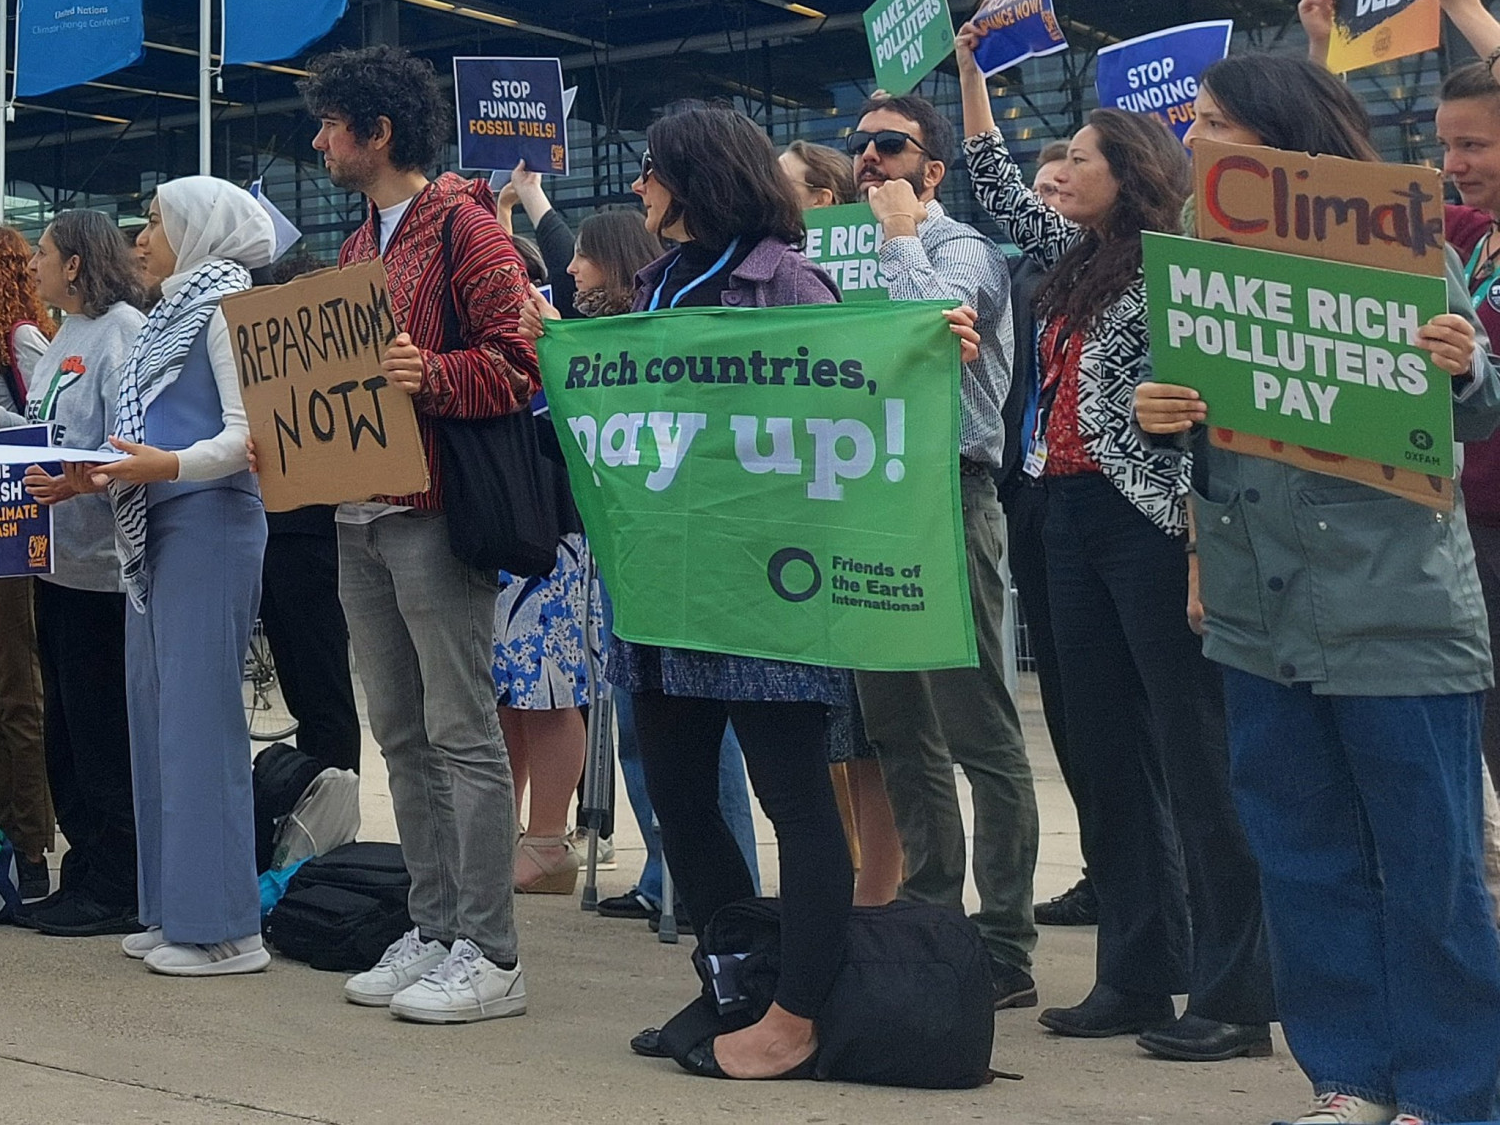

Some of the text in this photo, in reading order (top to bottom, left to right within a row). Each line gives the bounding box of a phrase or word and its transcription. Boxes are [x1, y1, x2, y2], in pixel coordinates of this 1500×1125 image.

[901, 35, 924, 75] PAY
[492, 80, 530, 98] STOP
[1128, 57, 1174, 89] STOP
[479, 100, 546, 120] FUNDING
[1116, 76, 1198, 113] FUNDING
[470, 119, 556, 139] FOSSIL FUELS!
[1169, 264, 1419, 347] MAKE RICH
[1167, 309, 1428, 395] POLLUTERS
[565, 346, 877, 396] Rich countries,
[1252, 371, 1340, 425] PAY
[274, 375, 388, 476] NOW
[730, 398, 906, 501] up!
[1404, 450, 1440, 466] OXFAM
[832, 556, 922, 578] Friends of
[832, 576, 924, 597] the Earth
[832, 593, 924, 612] International
